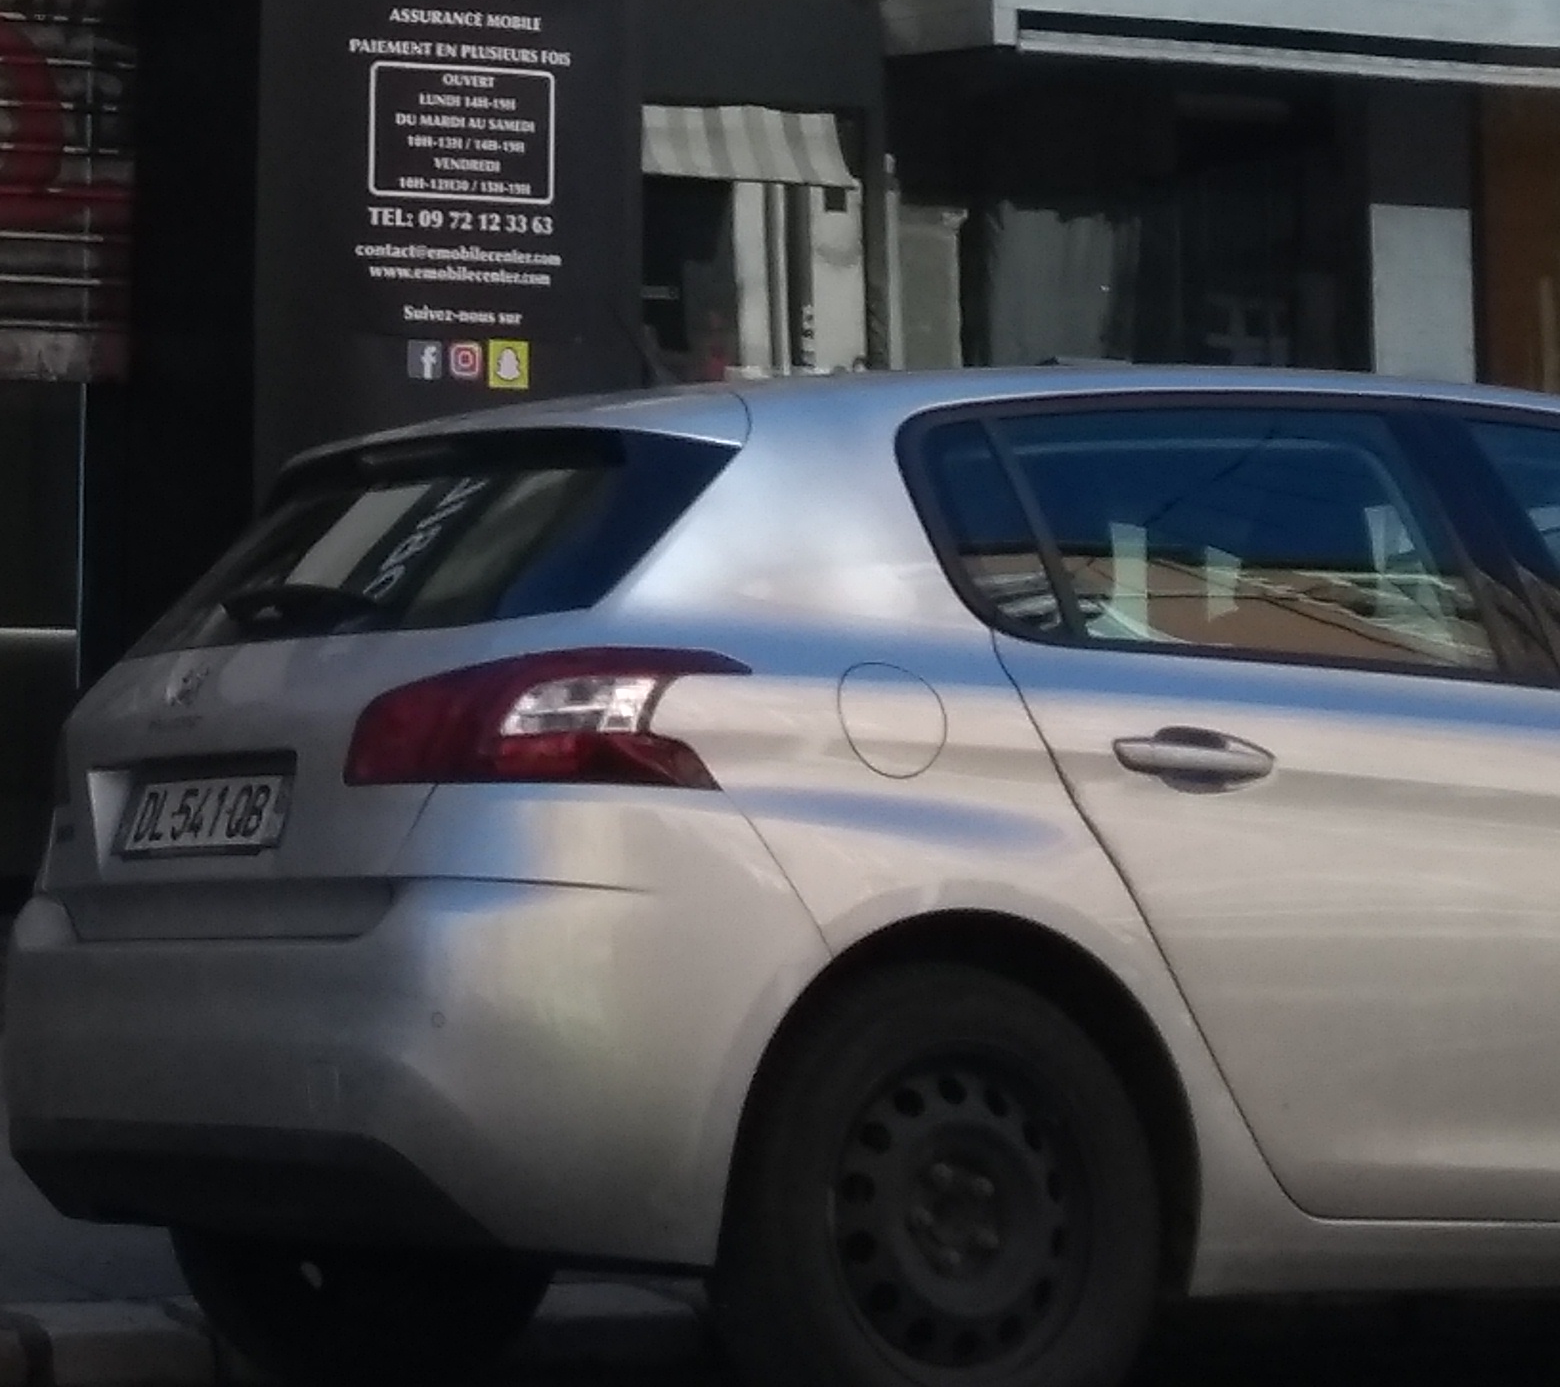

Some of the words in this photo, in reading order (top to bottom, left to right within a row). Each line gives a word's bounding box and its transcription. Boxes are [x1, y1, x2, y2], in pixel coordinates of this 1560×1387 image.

[389, 8, 482, 27] ASSURANCE
[487, 14, 541, 32] MOBILE
[349, 38, 432, 56] PAIEMENT
[436, 43, 456, 58] EN
[461, 44, 538, 64] PLUSIEURS
[541, 50, 571, 66] FOIS
[443, 73, 495, 88] OUVERT
[419, 92, 461, 107] LUNDI
[395, 112, 417, 125] DU
[419, 114, 465, 128] MARDI
[468, 117, 486, 129] AU
[488, 118, 536, 133] SAMEDI
[433, 157, 501, 172] VENDREDI
[368, 206, 412, 227] TEL:
[419, 209, 442, 227] 09
[449, 211, 472, 231] 72
[478, 212, 501, 232] 12
[506, 214, 527, 233] 33
[532, 216, 553, 235] 63
[403, 305, 495, 324] Suivez-nous
[498, 311, 523, 325] sur
